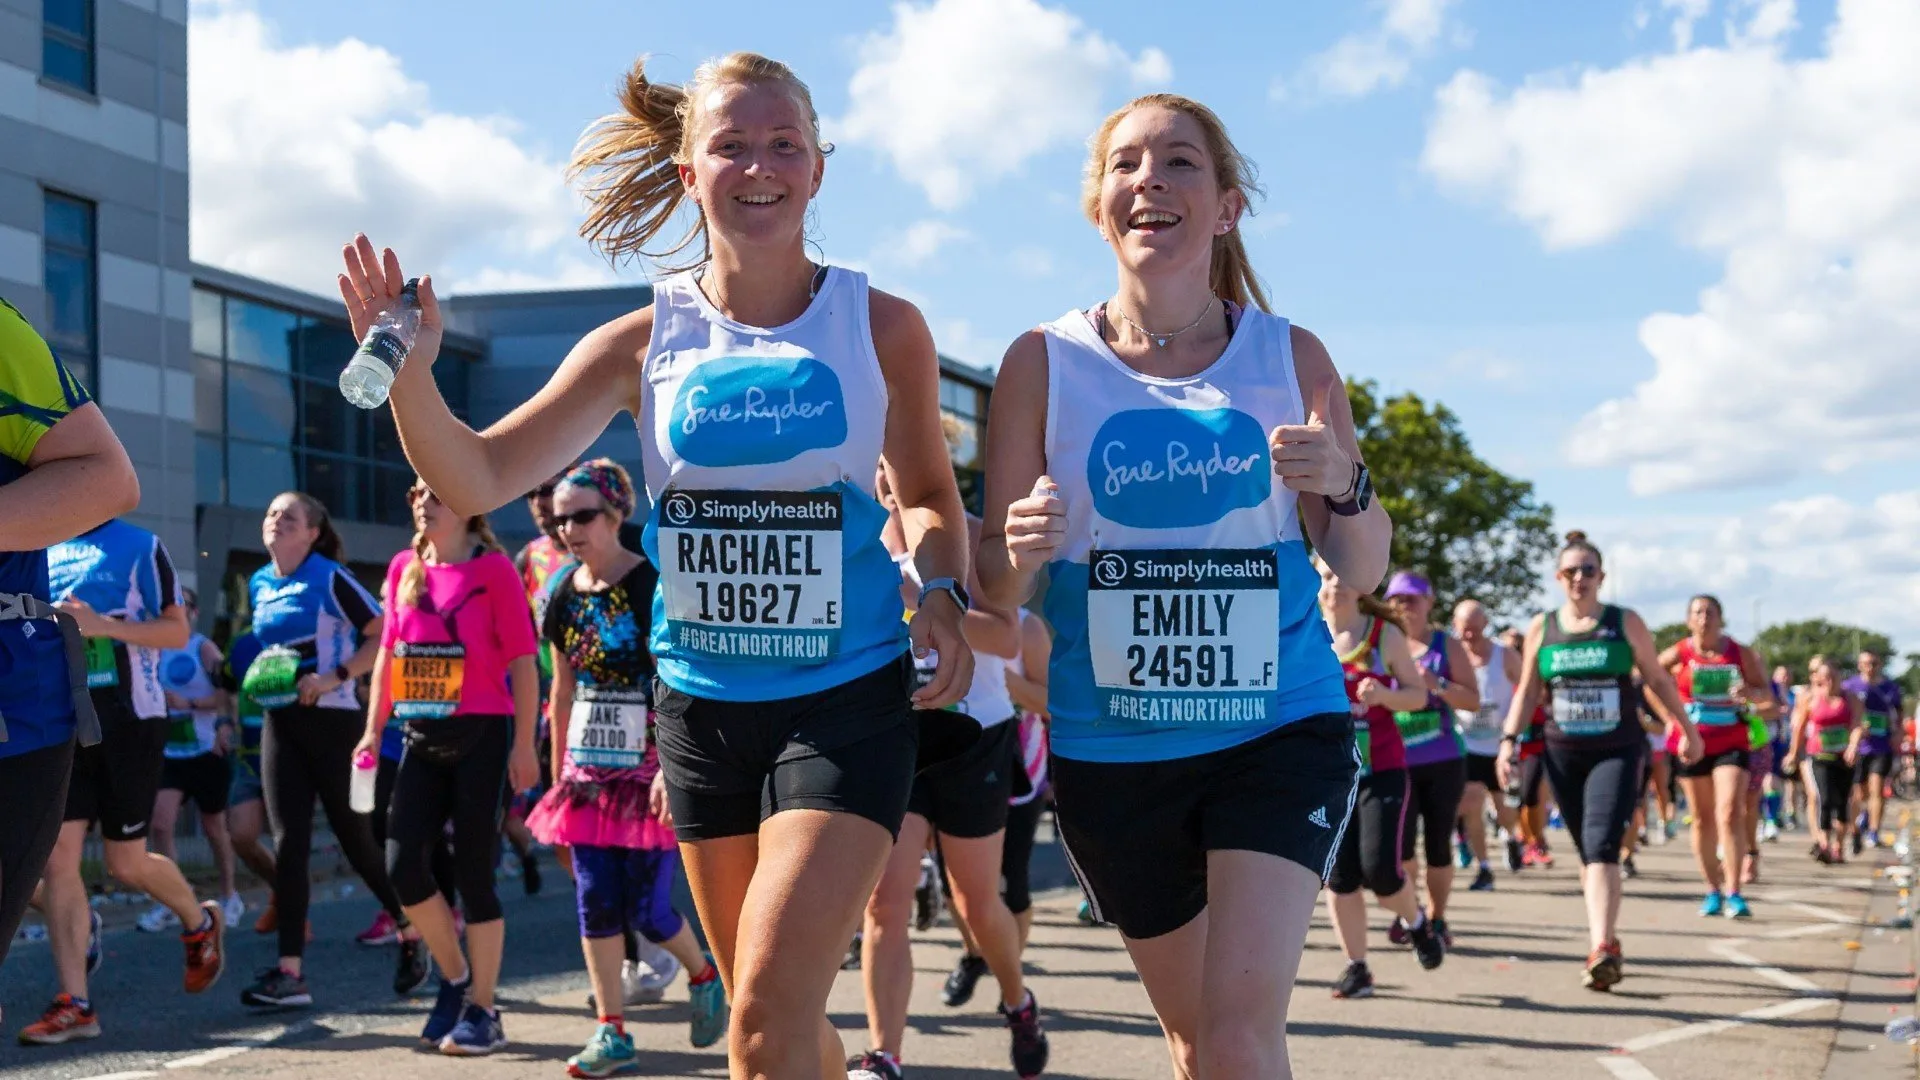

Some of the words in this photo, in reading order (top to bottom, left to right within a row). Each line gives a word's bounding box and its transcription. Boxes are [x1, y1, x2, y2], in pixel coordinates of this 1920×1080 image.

[682, 385, 742, 435] Sue
[743, 386, 833, 435] Ryder
[1103, 440, 1165, 496] Sue
[1166, 440, 1261, 494] Ryder
[701, 500, 838, 523] Simplyhealth
[677, 531, 823, 577] RACHAEL
[1133, 559, 1274, 583] Simplyhealth
[695, 580, 803, 626] 19627
[826, 600, 837, 625] E
[1131, 593, 1235, 637] EMILY
[679, 626, 830, 658] #GREATNORTHRUN
[402, 658, 452, 678] ANGELA
[1126, 643, 1240, 688] 24591
[1262, 660, 1274, 687] F
[586, 705, 622, 726] JANE
[1109, 694, 1266, 722] #GREATNORTHRUN
[581, 728, 627, 749] 20100
